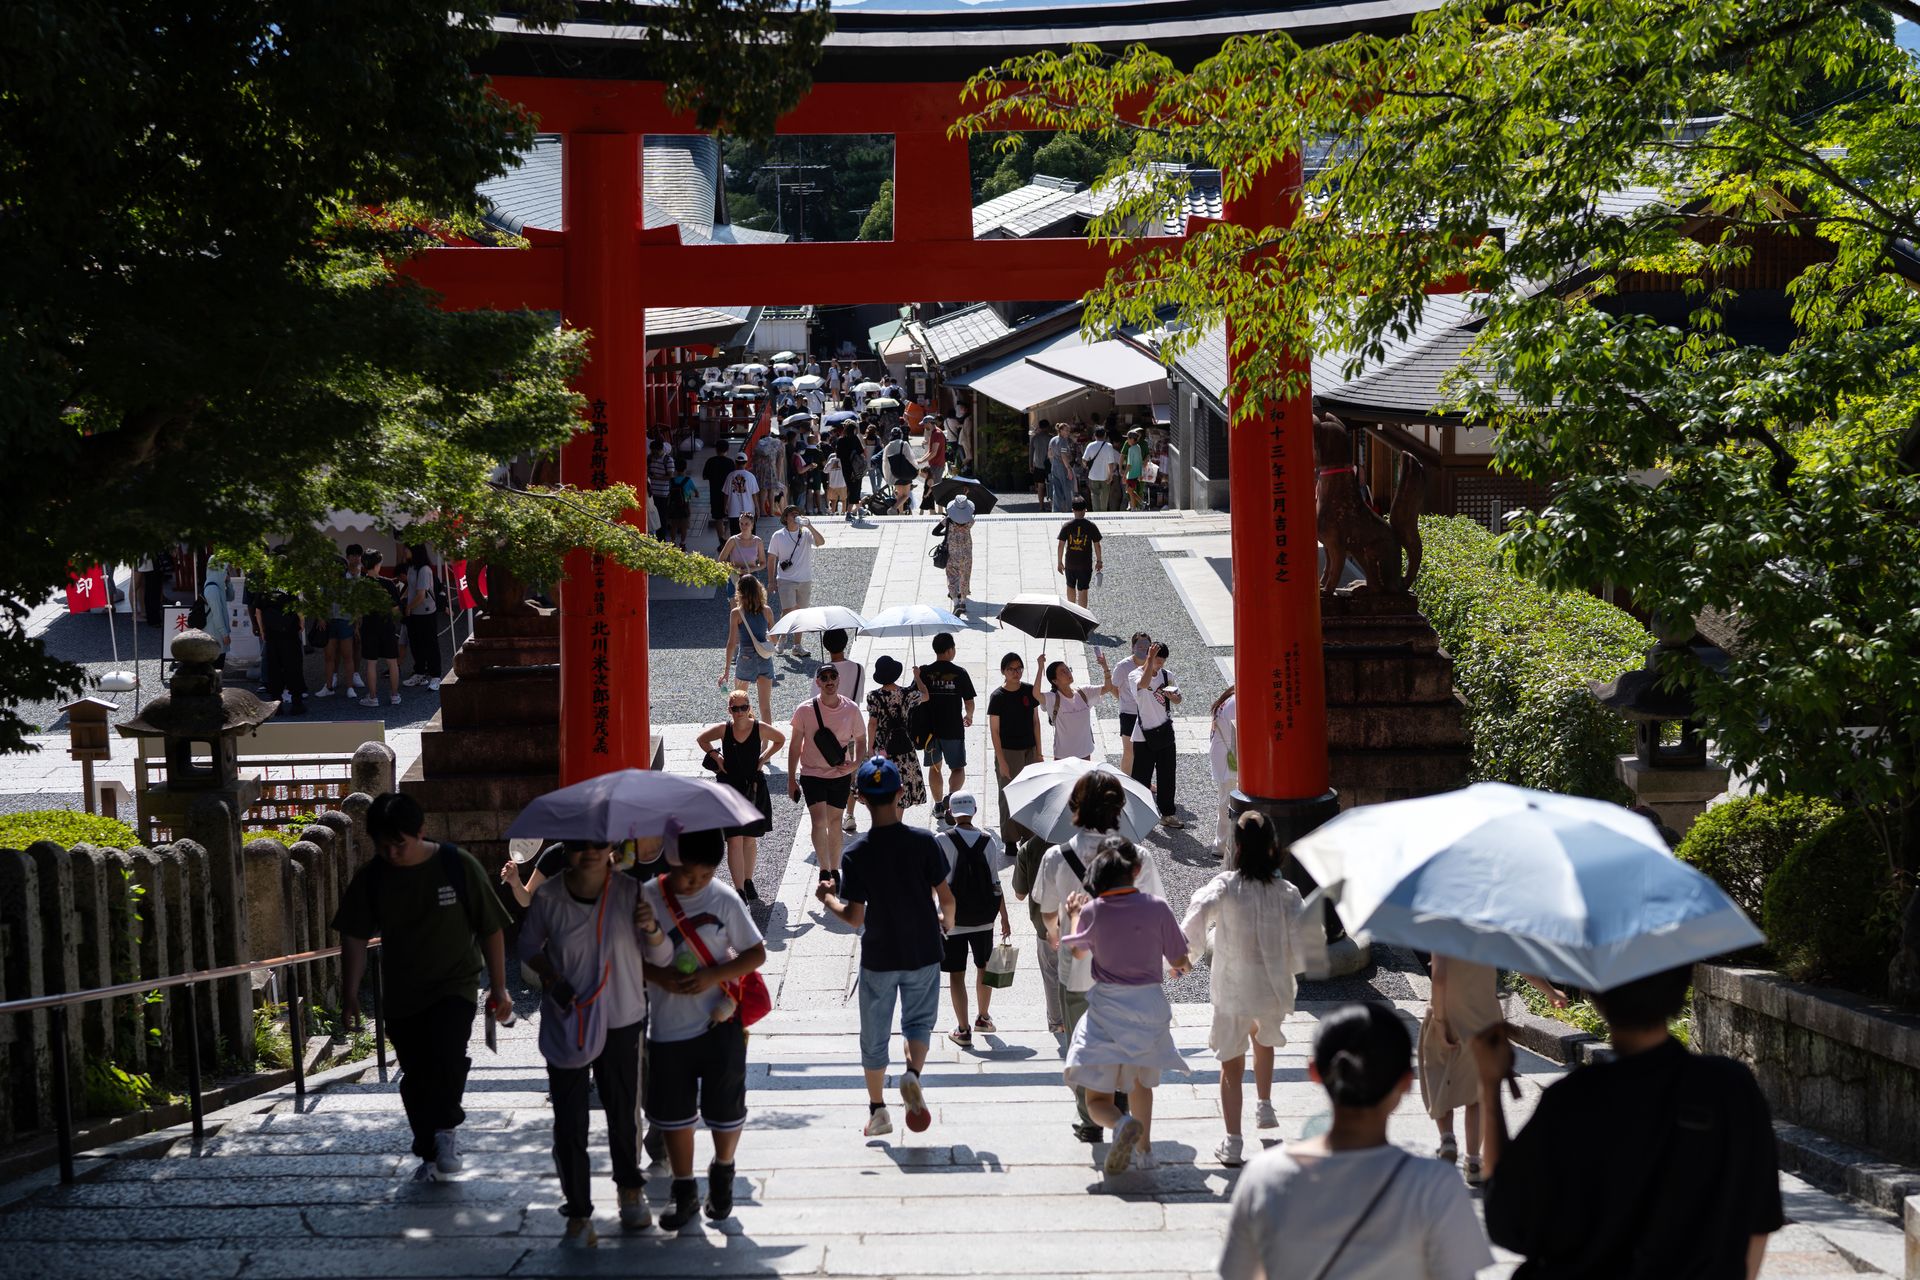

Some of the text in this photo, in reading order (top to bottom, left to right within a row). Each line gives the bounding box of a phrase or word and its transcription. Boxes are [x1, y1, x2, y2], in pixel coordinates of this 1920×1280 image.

[1269, 394, 1290, 583] 和十三年三月吉日建之
[76, 577, 93, 598] 印
